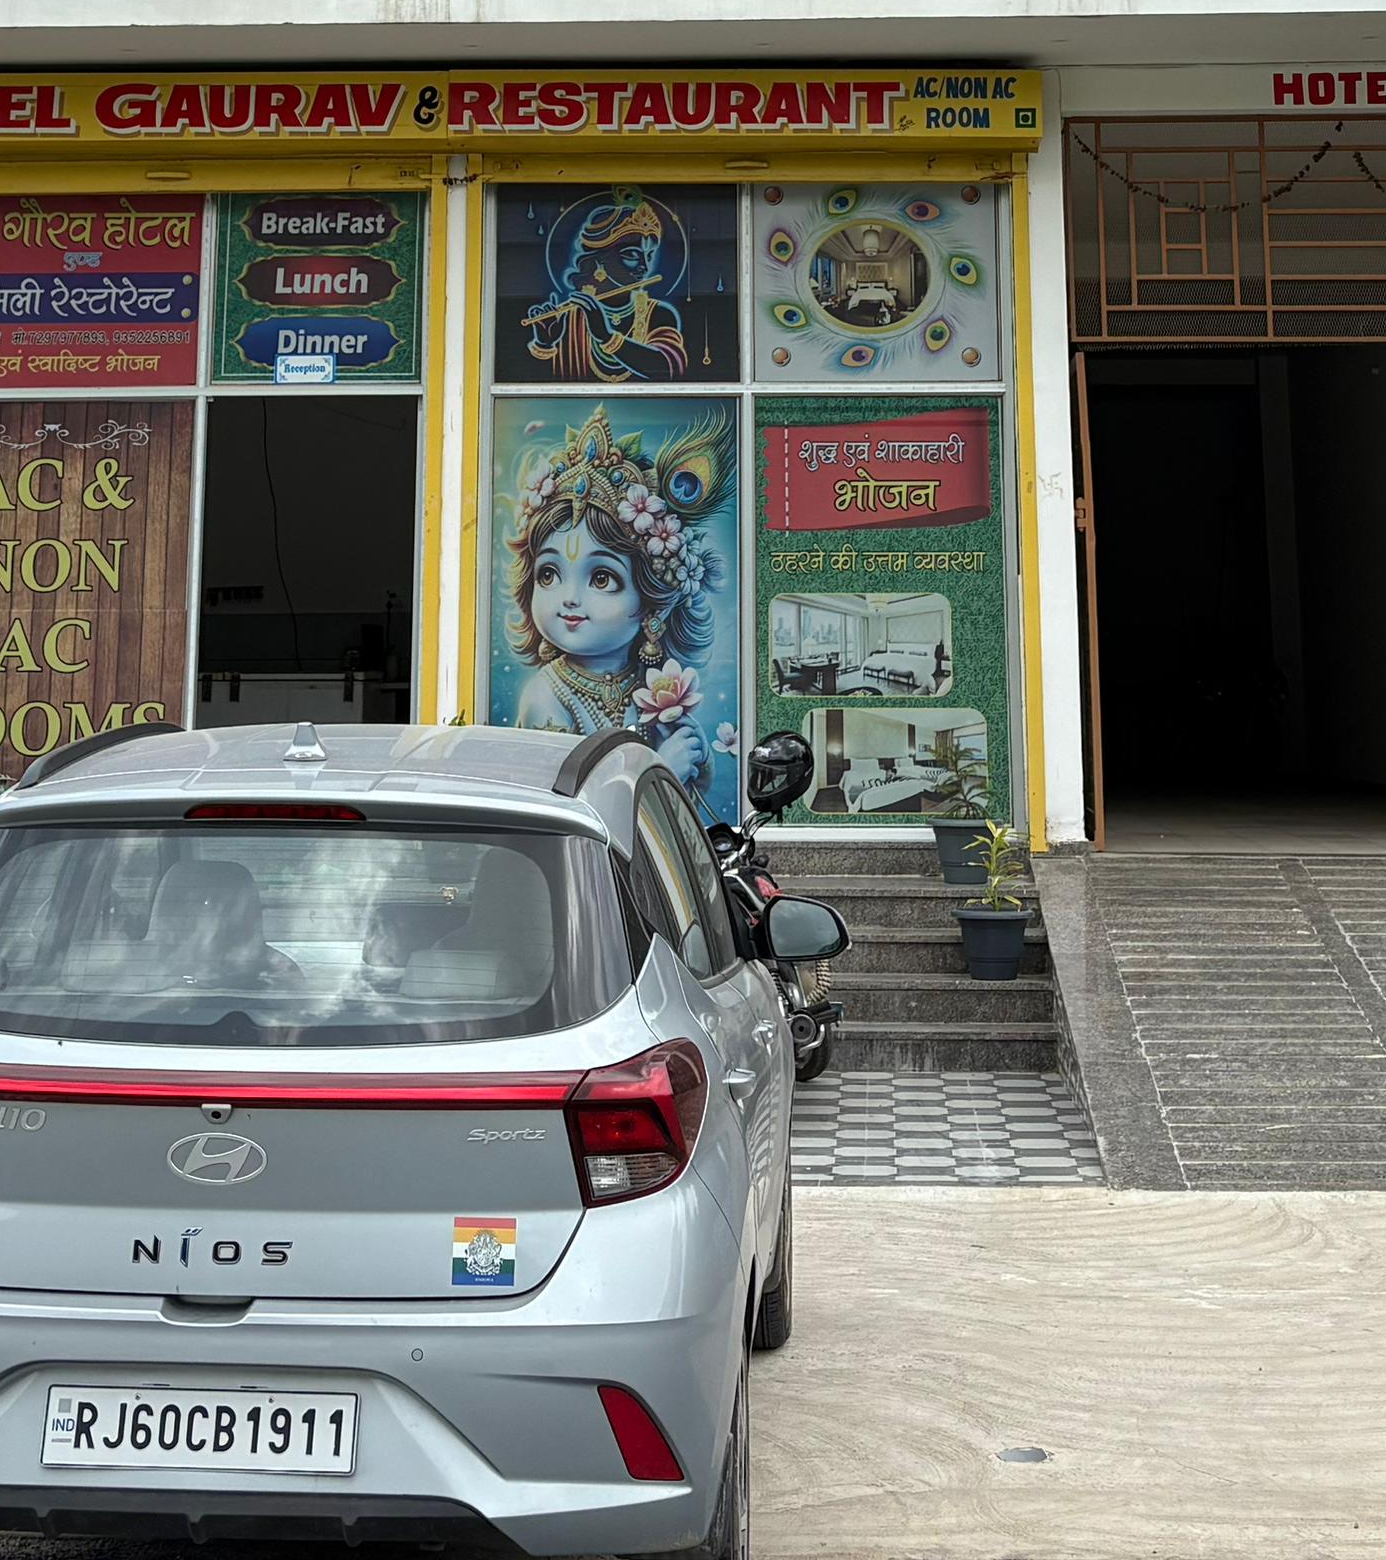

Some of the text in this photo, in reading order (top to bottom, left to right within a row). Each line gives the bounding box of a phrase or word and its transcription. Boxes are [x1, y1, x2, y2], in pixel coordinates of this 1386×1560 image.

[913, 75, 1017, 100] AC/NON AC
[94, 83, 404, 133] GAURAV
[412, 84, 440, 127] &
[447, 81, 908, 131] RESTAURANT
[925, 106, 991, 129] ROOM
[3, 196, 197, 250] गौरव होटल
[261, 211, 386, 235] Break-Fast
[274, 267, 369, 294] Lunch
[277, 329, 368, 354] Dinner
[106, 347, 162, 373] भोजन
[283, 362, 327, 375] Reception
[842, 433, 871, 468] एवं
[875, 433, 965, 464] शाकाहारी
[82, 457, 136, 512] &
[833, 466, 941, 512] भोजन
[770, 542, 986, 574] ठहरने की उत्तम व्यवस्था
[466, 1128, 547, 1145] Sportz
[51, 1400, 345, 1458] IND RJ60CB1911
